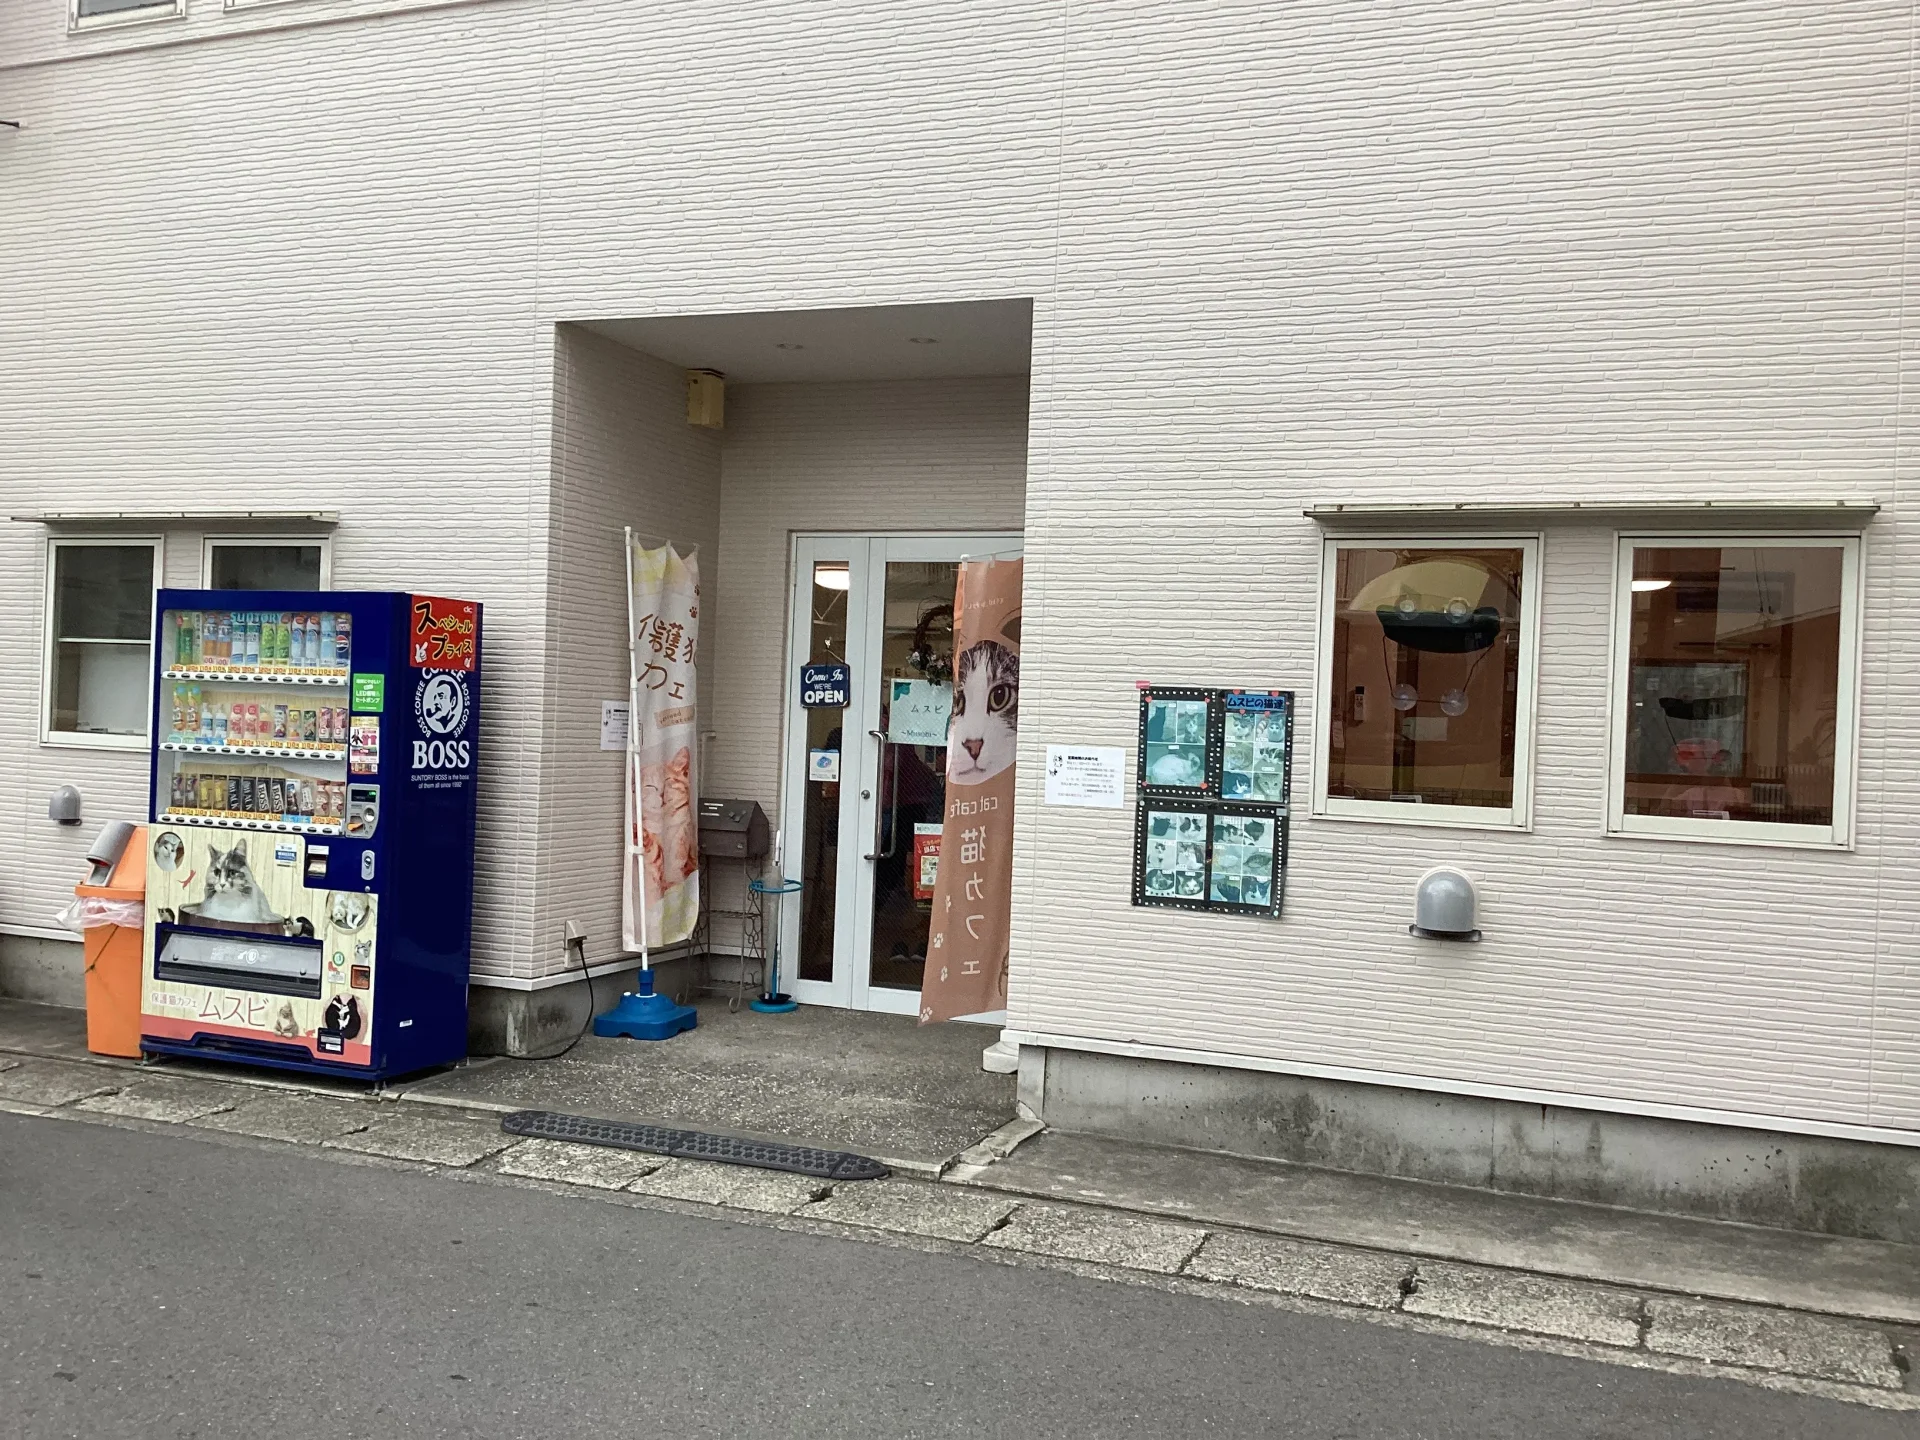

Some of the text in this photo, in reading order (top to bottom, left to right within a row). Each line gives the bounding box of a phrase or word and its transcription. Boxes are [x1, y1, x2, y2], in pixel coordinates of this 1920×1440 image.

[415, 601, 473, 634] スペシャル
[430, 633, 473, 660] プライス
[638, 614, 697, 670] 保護
[461, 682, 470, 707] BOSS
[804, 690, 844, 703] OPEN
[411, 740, 470, 769] BOSS
[411, 774, 434, 782] SUNTORY
[258, 784, 269, 811] BOSS
[272, 786, 283, 811] BOSS
[199, 991, 269, 1027] ムスビ
